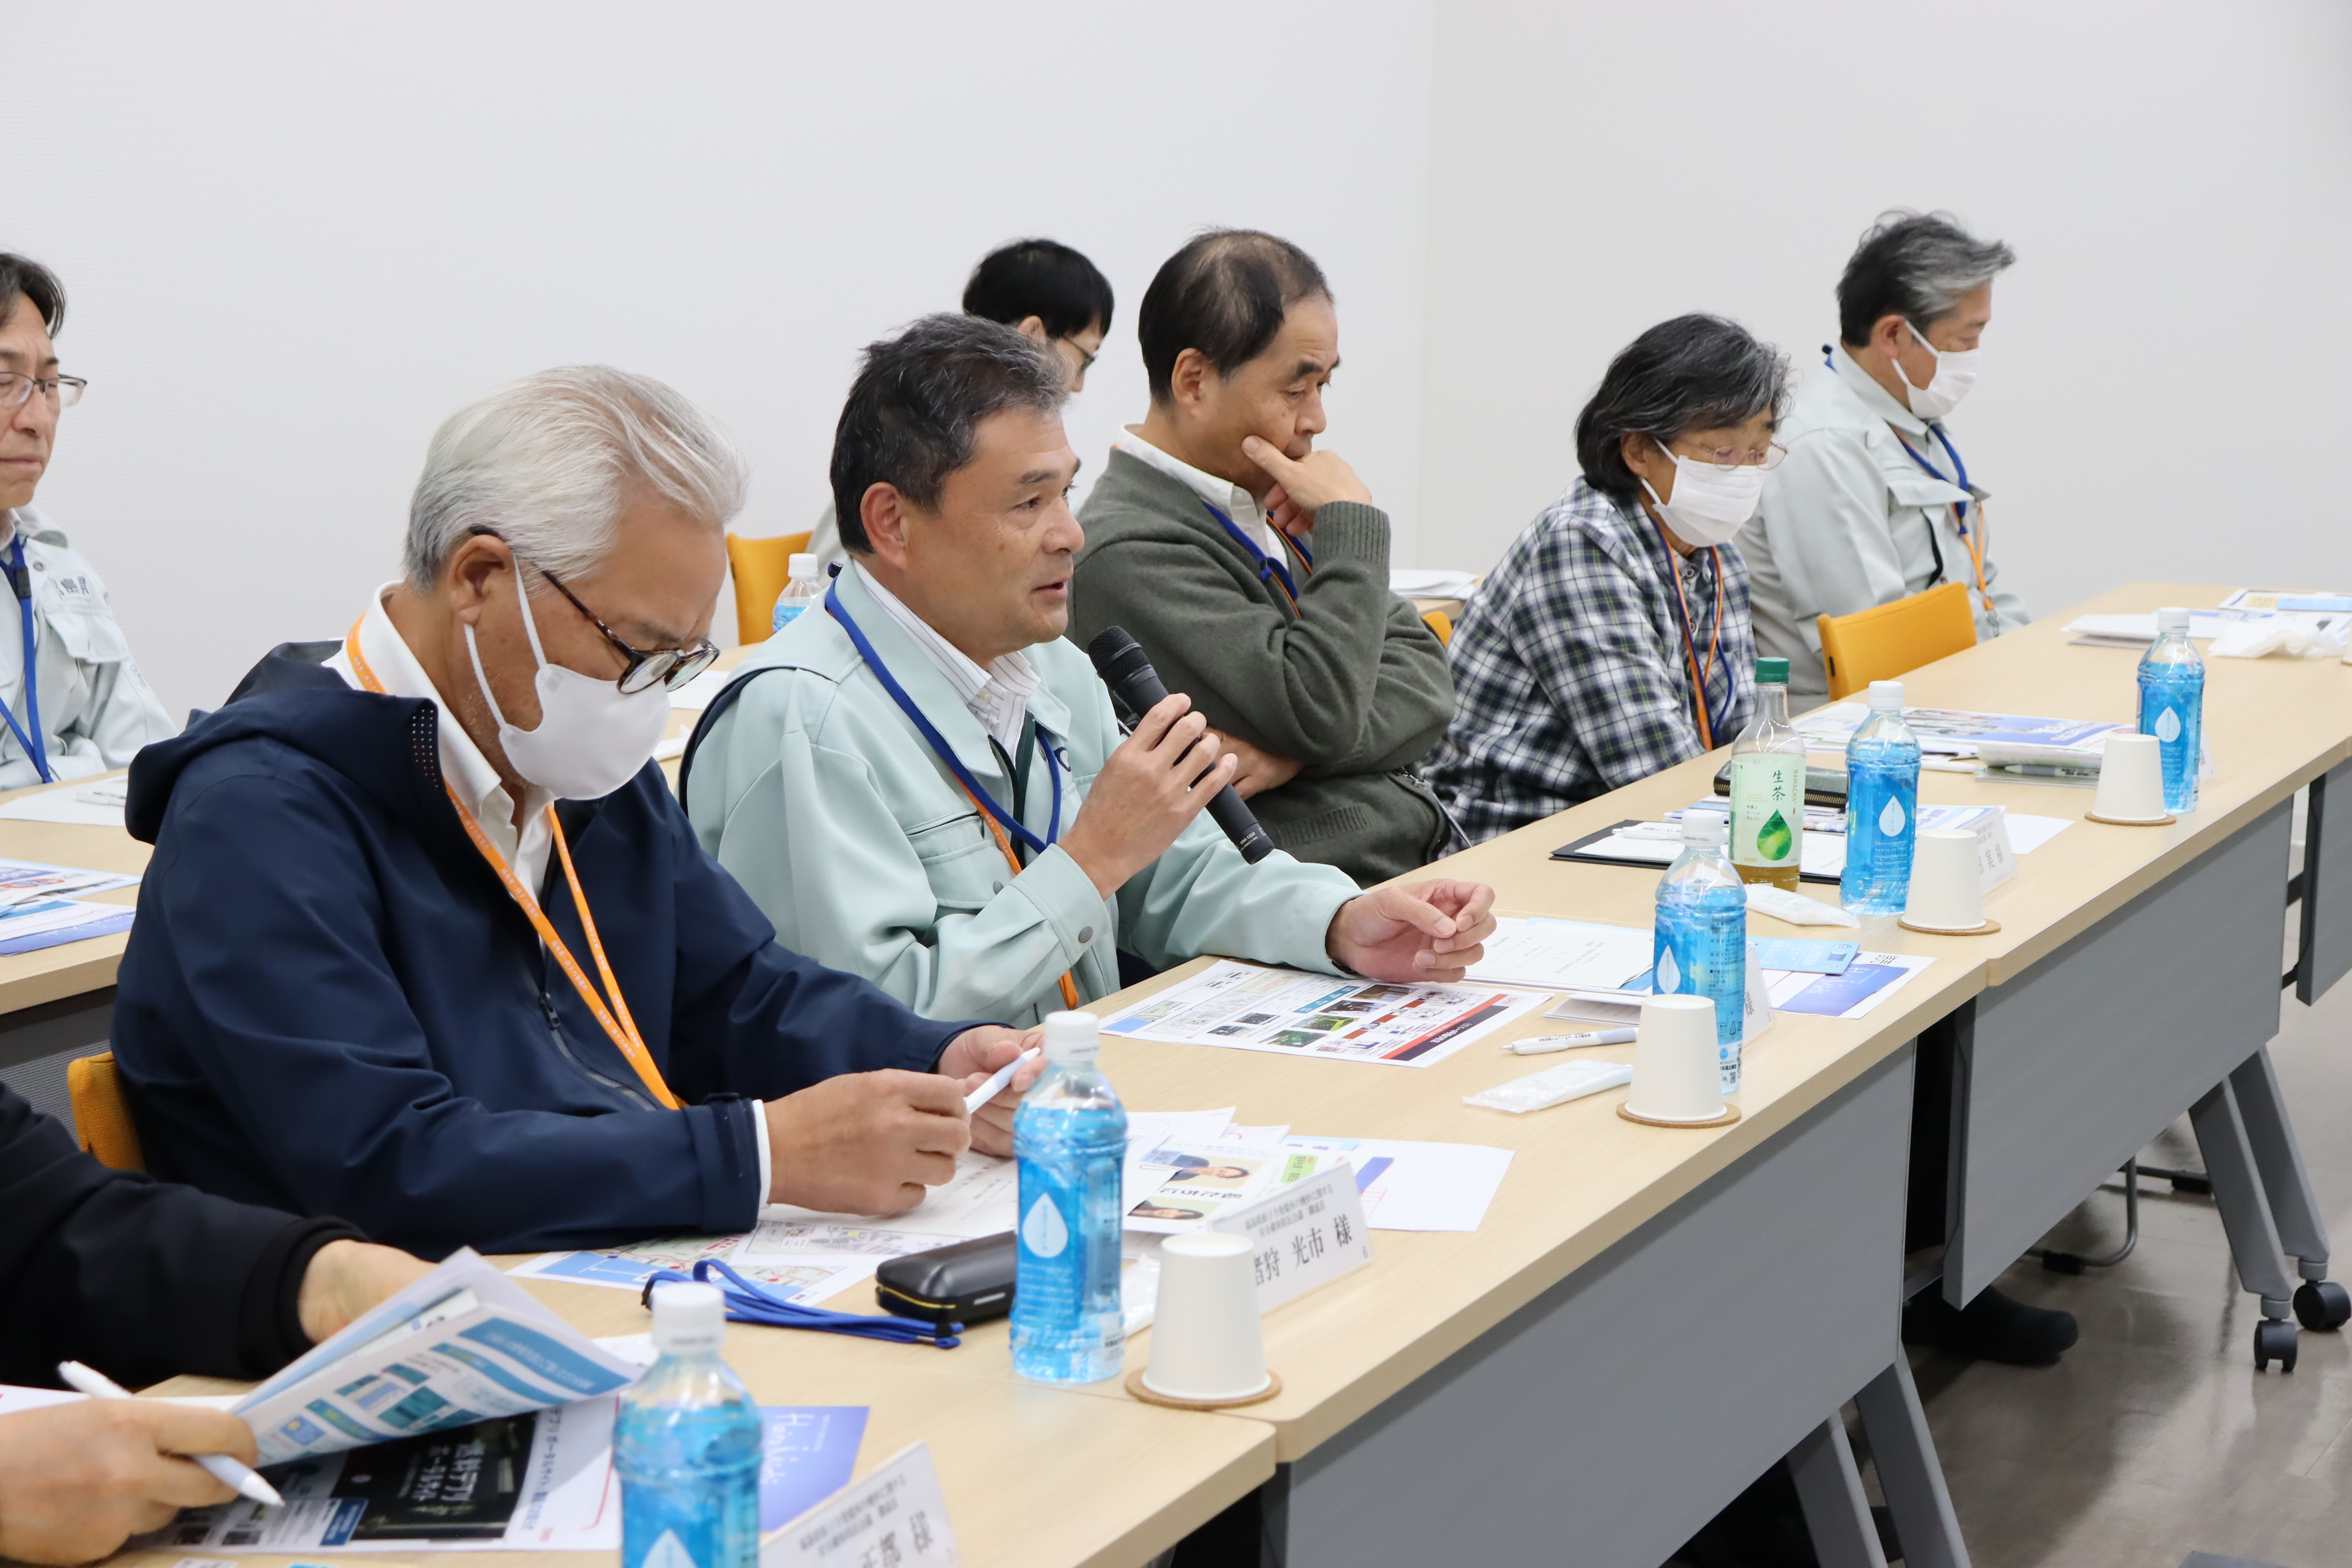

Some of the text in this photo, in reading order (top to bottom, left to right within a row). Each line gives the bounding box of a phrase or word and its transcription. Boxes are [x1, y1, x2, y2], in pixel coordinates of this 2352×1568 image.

[52, 577, 89, 595] 島県
[1772, 770, 1786, 801] 生茶
[1292, 1228, 1324, 1269] 光市
[1334, 1214, 1353, 1247] 様
[1363, 1246, 1368, 1258] 6
